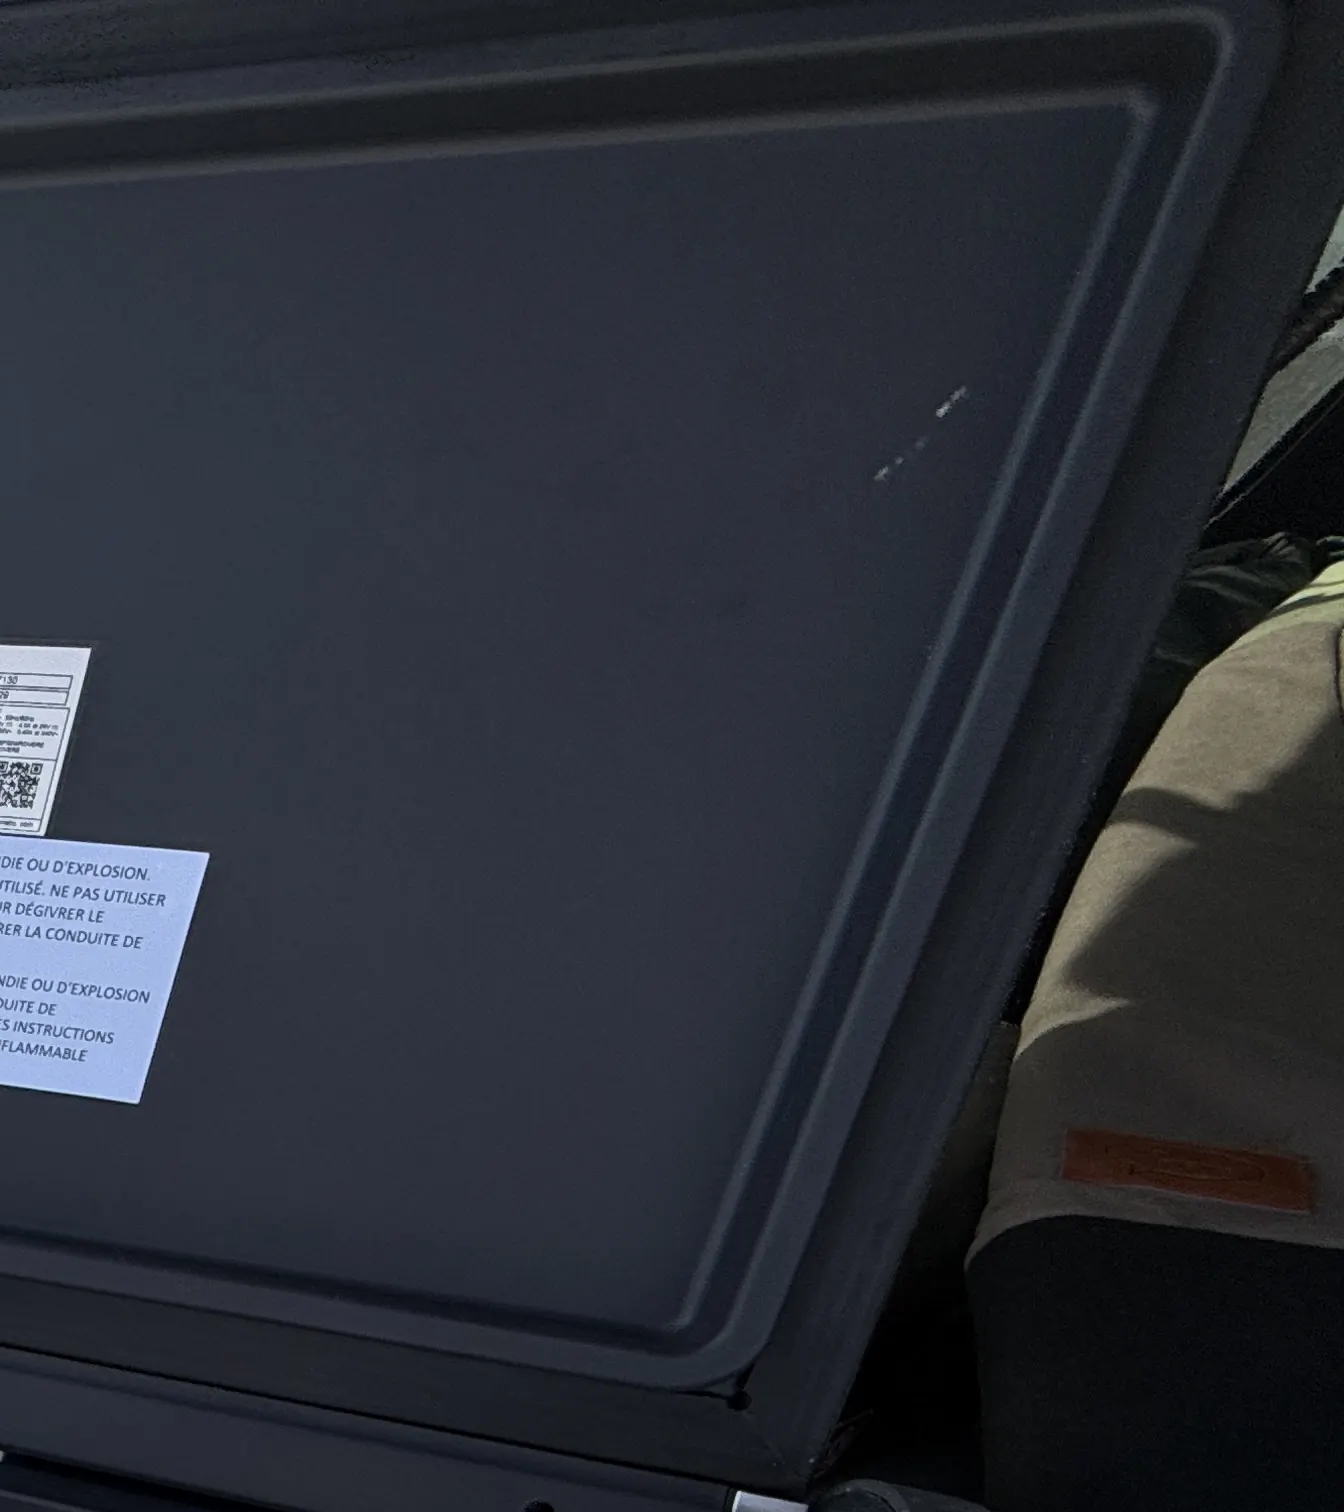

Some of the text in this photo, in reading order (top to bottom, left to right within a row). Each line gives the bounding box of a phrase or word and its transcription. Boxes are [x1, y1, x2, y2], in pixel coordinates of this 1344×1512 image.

[26, 857, 50, 873] OU
[49, 884, 70, 899] NE
[72, 886, 101, 901] PAS
[103, 889, 166, 907] UTILISER
[15, 901, 85, 921] DÉGIVRER
[87, 909, 105, 924] LE
[24, 925, 41, 939] LA
[45, 927, 120, 947] CONDUITE
[122, 935, 144, 950] DE
[31, 978, 54, 993] OU
[37, 1002, 57, 1016] DE
[13, 1021, 114, 1044] INSTRUCTIONS
